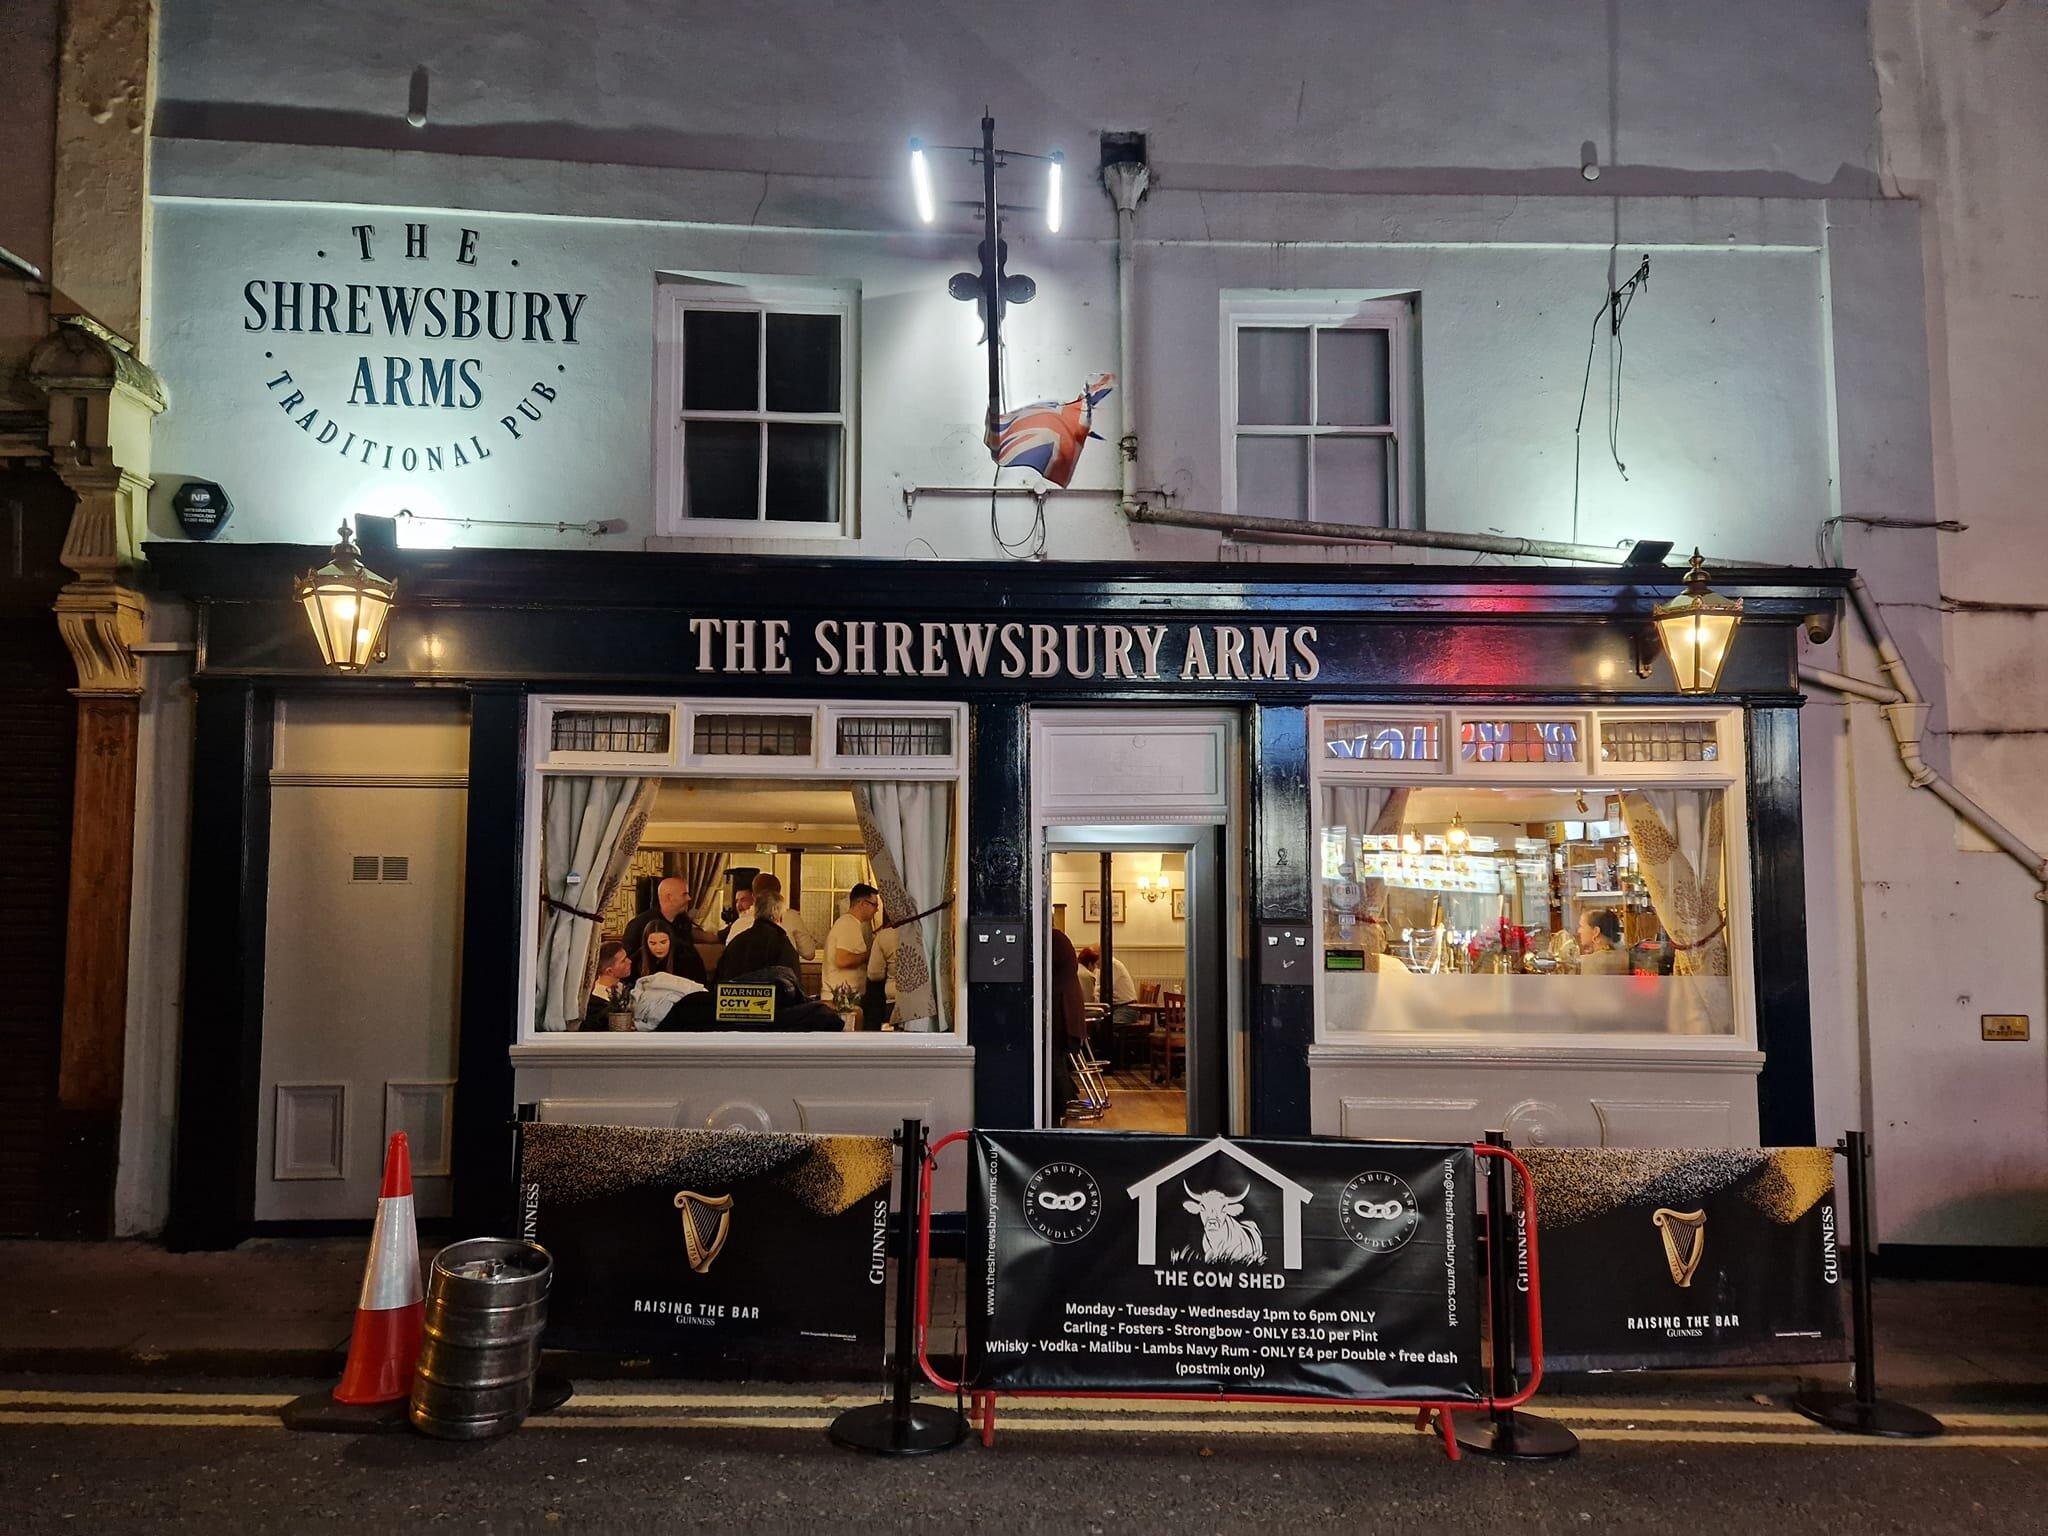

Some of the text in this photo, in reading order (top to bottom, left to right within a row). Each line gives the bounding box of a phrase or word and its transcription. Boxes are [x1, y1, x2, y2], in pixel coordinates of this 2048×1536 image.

[352, 223, 480, 267] THE
[244, 279, 588, 345] SHREWSBURY
[347, 356, 483, 410] ARMS
[266, 369, 557, 473] TRADITIONAL PUB
[191, 493, 210, 502] NP
[689, 618, 1320, 682] THE SHREWSBURY ARMS
[720, 999, 750, 1008] CCTV
[722, 988, 770, 997] WARNING
[1027, 1165, 1098, 1216] SHREWSBURY ARMS
[1342, 1173, 1400, 1224] SHREWSBURY
[524, 1183, 539, 1246] UINNESS
[985, 1145, 1000, 1316] www.theshrewsburyarms.co.uk
[1038, 1223, 1084, 1239] DUDLEY
[1355, 1232, 1402, 1248] DUDLEY
[869, 1200, 888, 1285] GUINNESS
[1444, 1159, 1459, 1327] info@theshrewsburyarms.co.uk
[1821, 1205, 1838, 1285] GUINNESS
[1154, 1270, 1286, 1289] THE COW SHED
[634, 1300, 759, 1319] RAISING THE BAR
[676, 1315, 716, 1327] GUINNESS
[1066, 1303, 1115, 1318] Monday
[1126, 1304, 1177, 1319] Tuesday
[1188, 1306, 1260, 1322] Wednesday
[1263, 1308, 1290, 1322] 1pm
[1293, 1309, 1306, 1321] to
[1309, 1310, 1337, 1324] 6pm
[1340, 1311, 1376, 1323] ONLY
[1063, 1321, 1108, 1336] Carling
[1118, 1323, 1164, 1335] Fosters
[1174, 1324, 1242, 1339] Strongbow
[1253, 1327, 1288, 1340] ONLY
[1292, 1328, 1326, 1341] £3.10
[1328, 1331, 1350, 1344] per
[1353, 1330, 1378, 1342] Pint
[1627, 1315, 1739, 1330] RAISING THE BAR
[1666, 1329, 1703, 1338] GUINNESS
[986, 1340, 1029, 1355] Whisky
[1040, 1340, 1078, 1353] Vodka
[1089, 1341, 1132, 1354] Malibu
[1142, 1342, 1183, 1355] Lambs
[1187, 1343, 1219, 1359] Navy
[1222, 1344, 1249, 1357] Rum
[1260, 1346, 1295, 1359] ONLY
[1298, 1348, 1314, 1359] £4
[1317, 1349, 1338, 1361] per
[1341, 1348, 1386, 1361] Double
[1399, 1349, 1425, 1363] free
[1428, 1351, 1458, 1364] dash
[1176, 1361, 1265, 1378] (postmix only)
